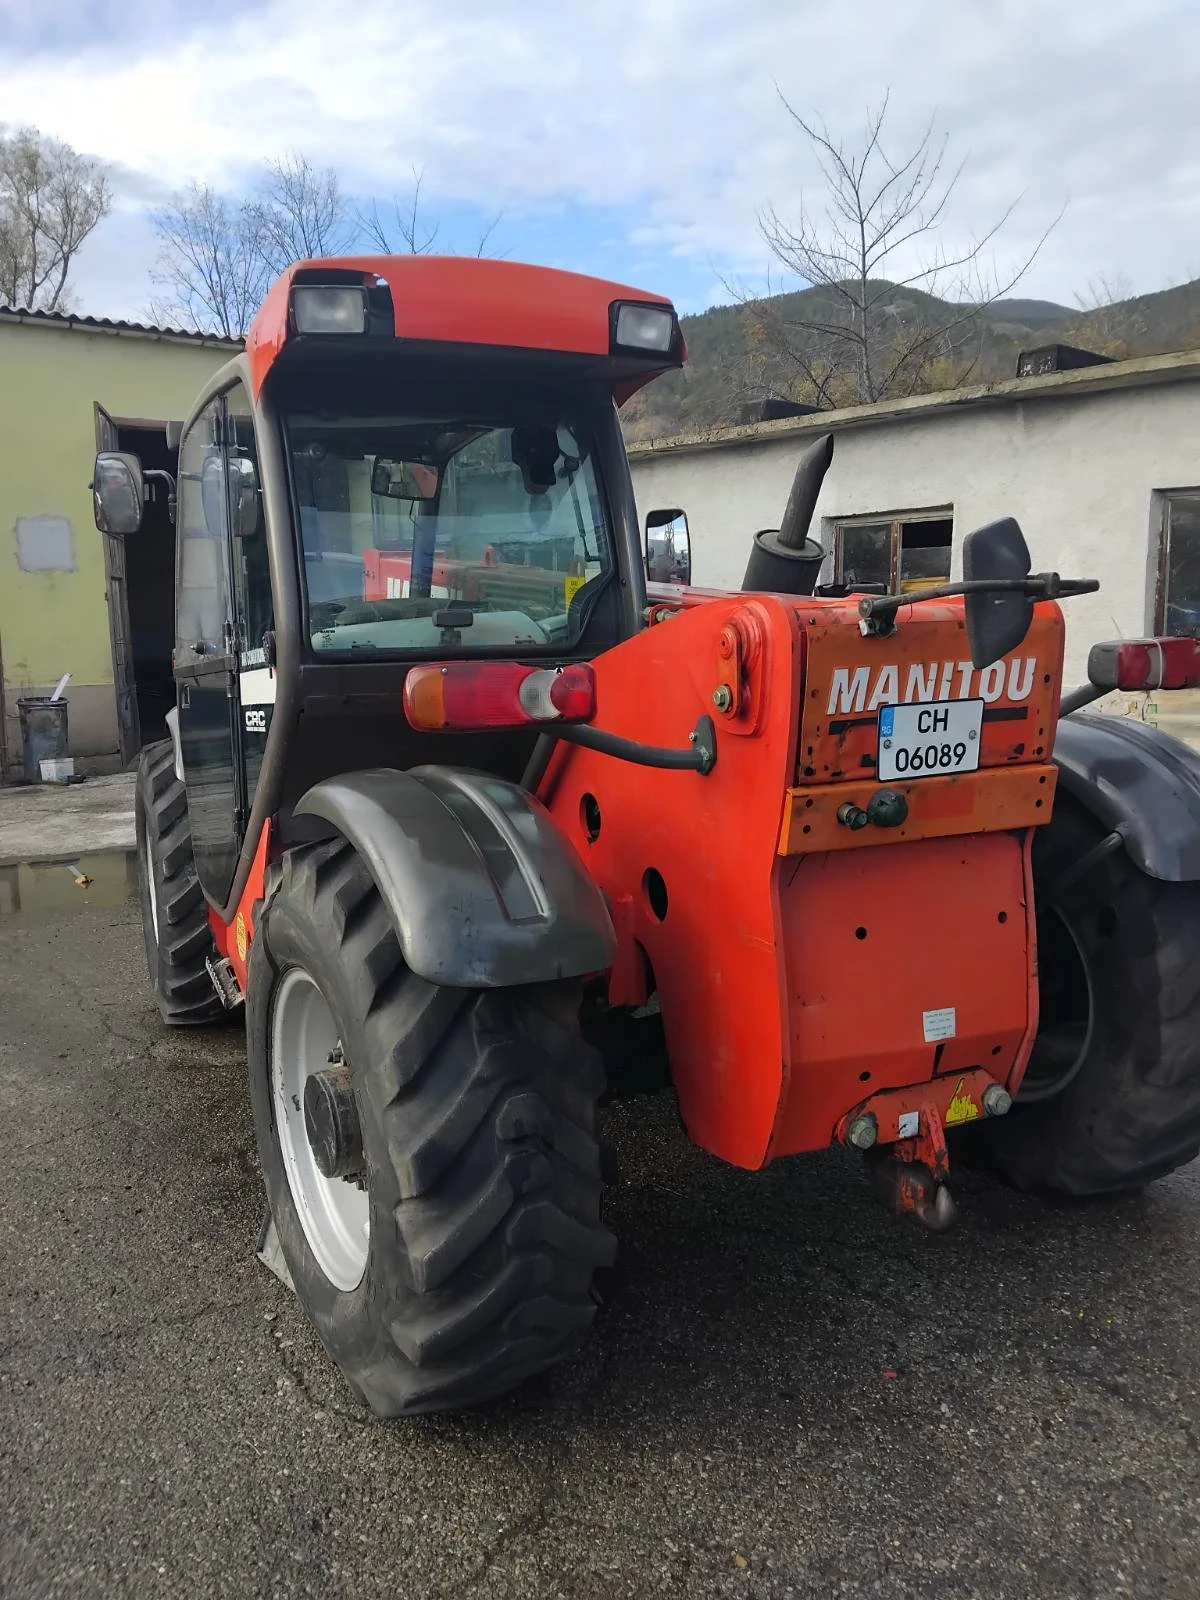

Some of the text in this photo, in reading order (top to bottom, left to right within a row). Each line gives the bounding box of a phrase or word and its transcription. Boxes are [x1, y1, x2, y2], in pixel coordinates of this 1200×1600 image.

[826, 658, 1036, 715] MANITOU
[917, 708, 949, 734] CH
[895, 742, 967, 772] 06089
